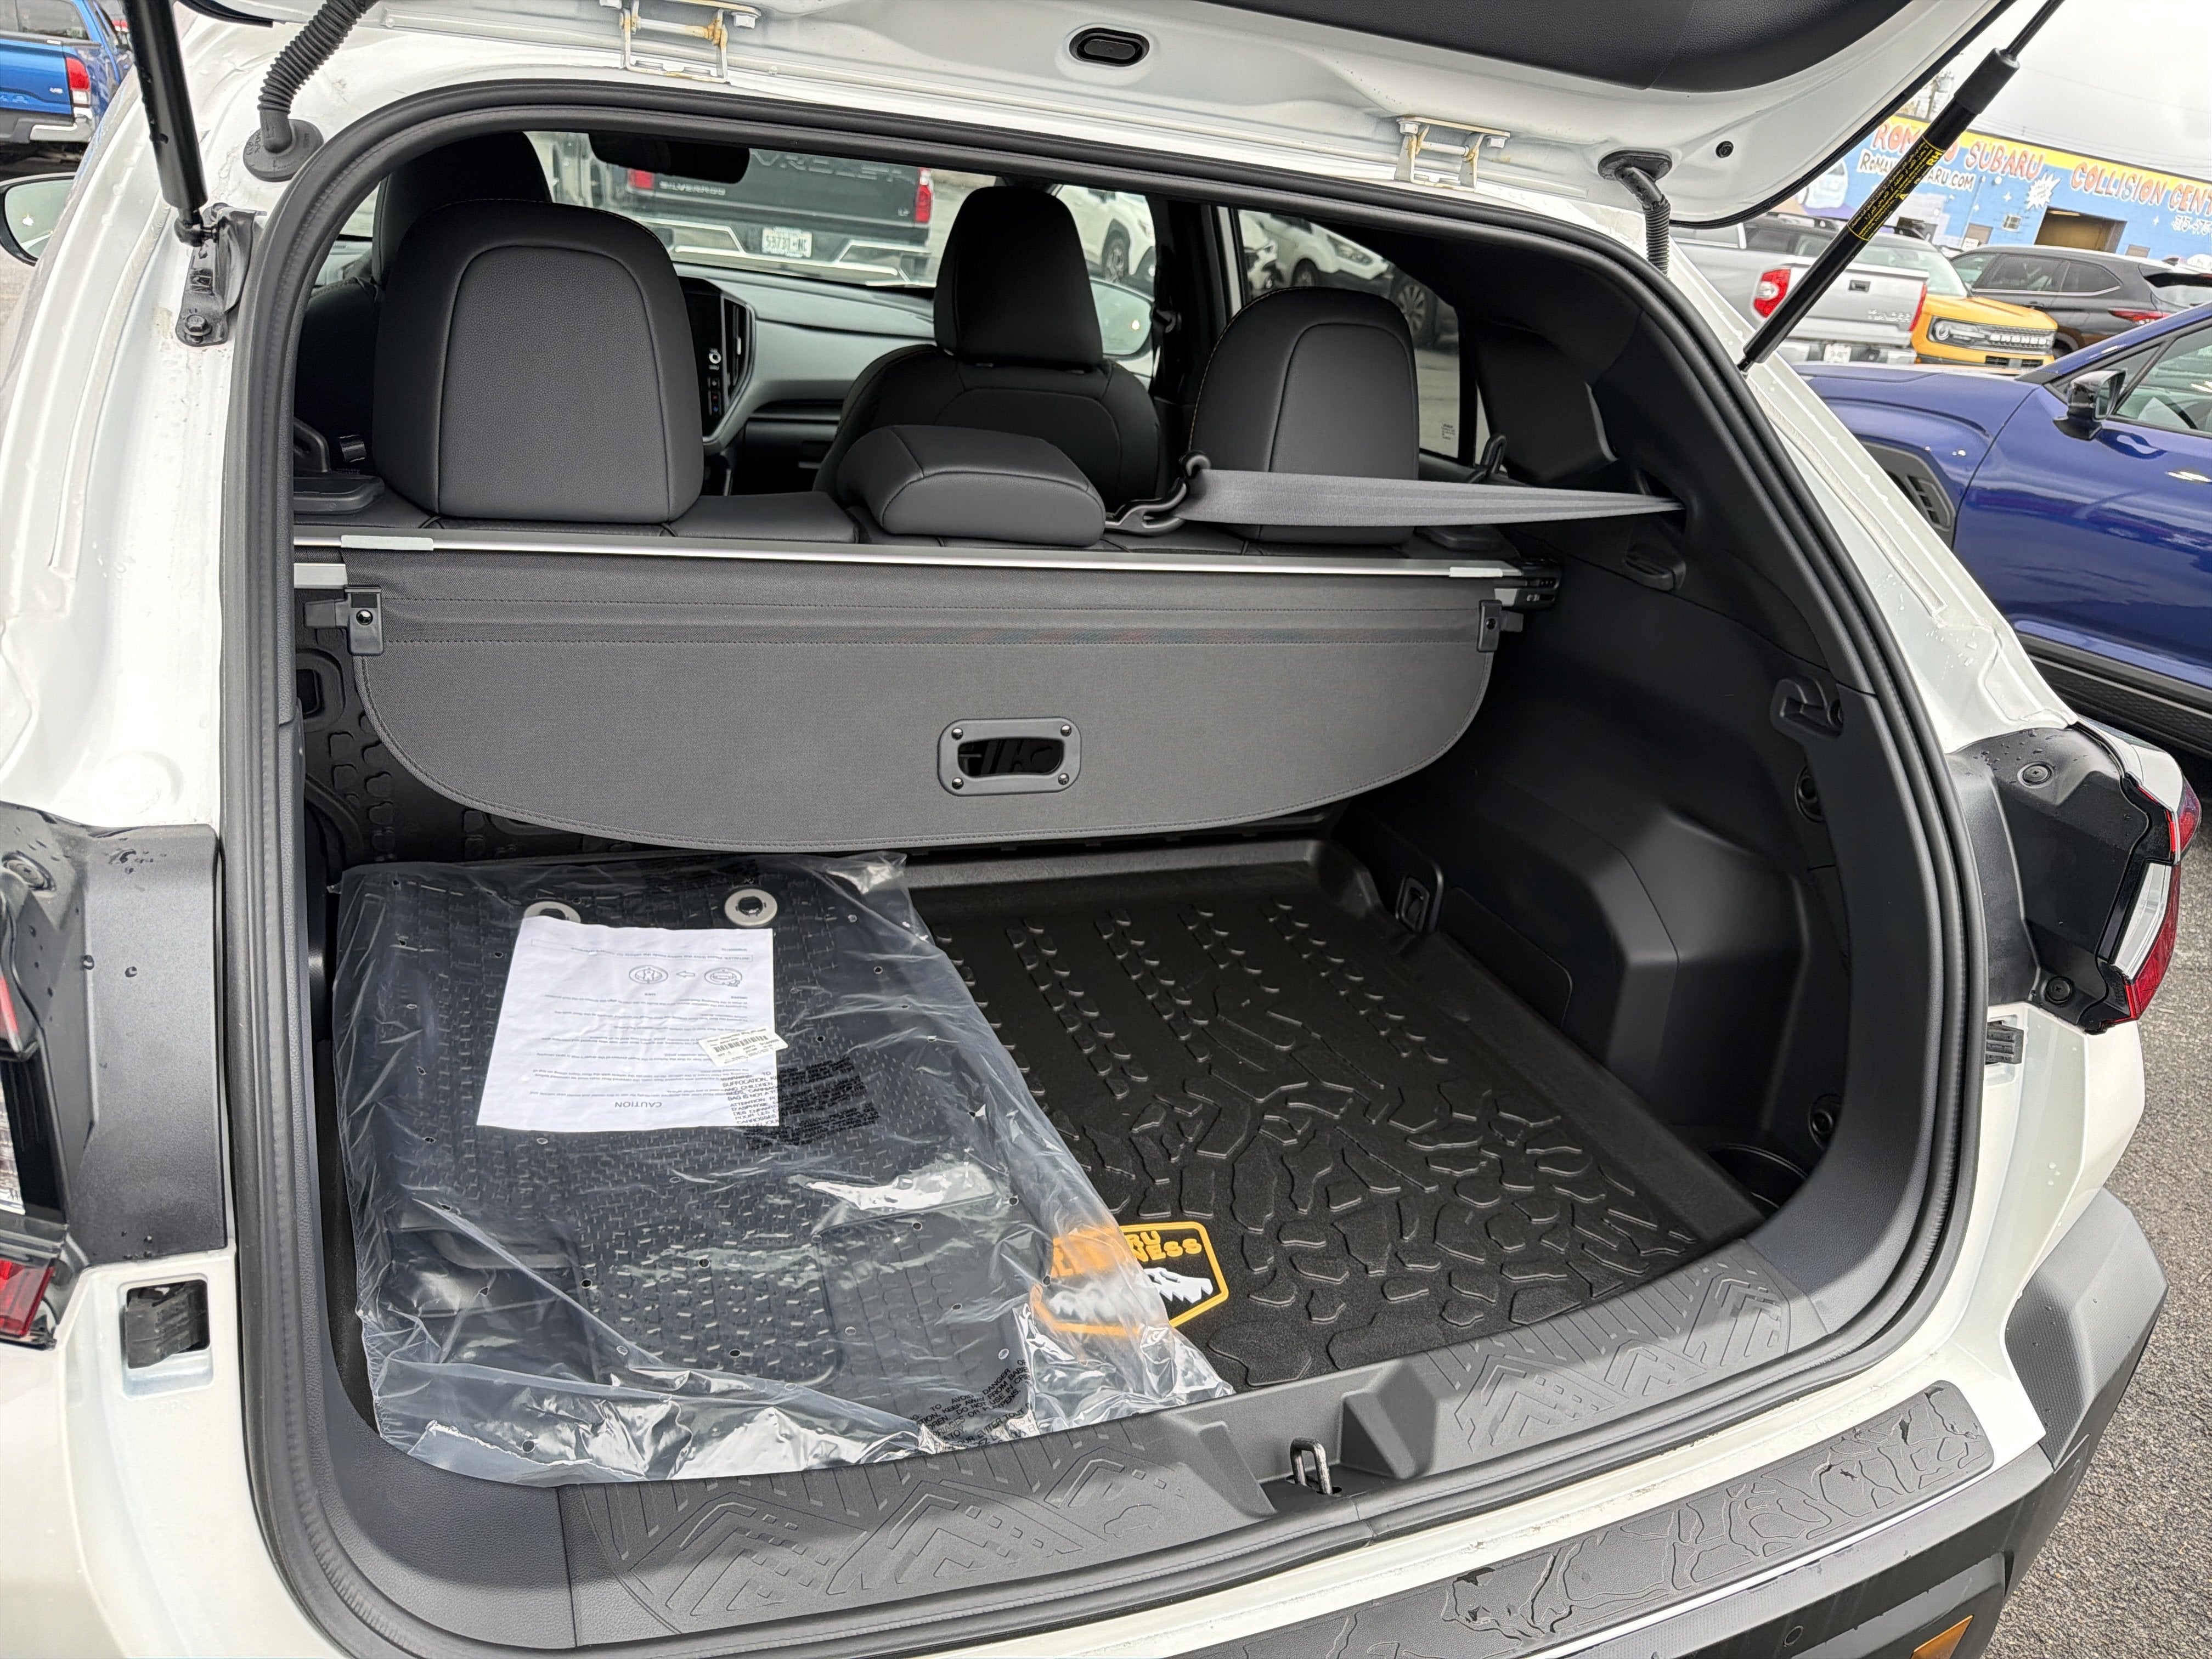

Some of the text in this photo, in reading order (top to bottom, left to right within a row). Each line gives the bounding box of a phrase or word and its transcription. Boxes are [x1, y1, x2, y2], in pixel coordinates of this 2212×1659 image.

[1873, 124, 1959, 162] ROMO
[1966, 142, 2044, 180] SUBARU
[2071, 162, 2168, 206] COLLISION
[1926, 151, 1943, 166] RH
[942, 1403, 962, 1414] KEEP
[964, 1397, 985, 1406] AWAY
[988, 1381, 1008, 1400] FROM
[951, 1394, 974, 1404] AVOID
[982, 1368, 1011, 1395] DANGER
[956, 1407, 969, 1415] DO
[970, 1402, 987, 1410] NOT
[989, 1395, 1006, 1406] USE
[1006, 1385, 1014, 1393] IN
[967, 1409, 981, 1418] OR
[950, 1425, 967, 1440] TOY.
[977, 1418, 1003, 1438] EVITER
